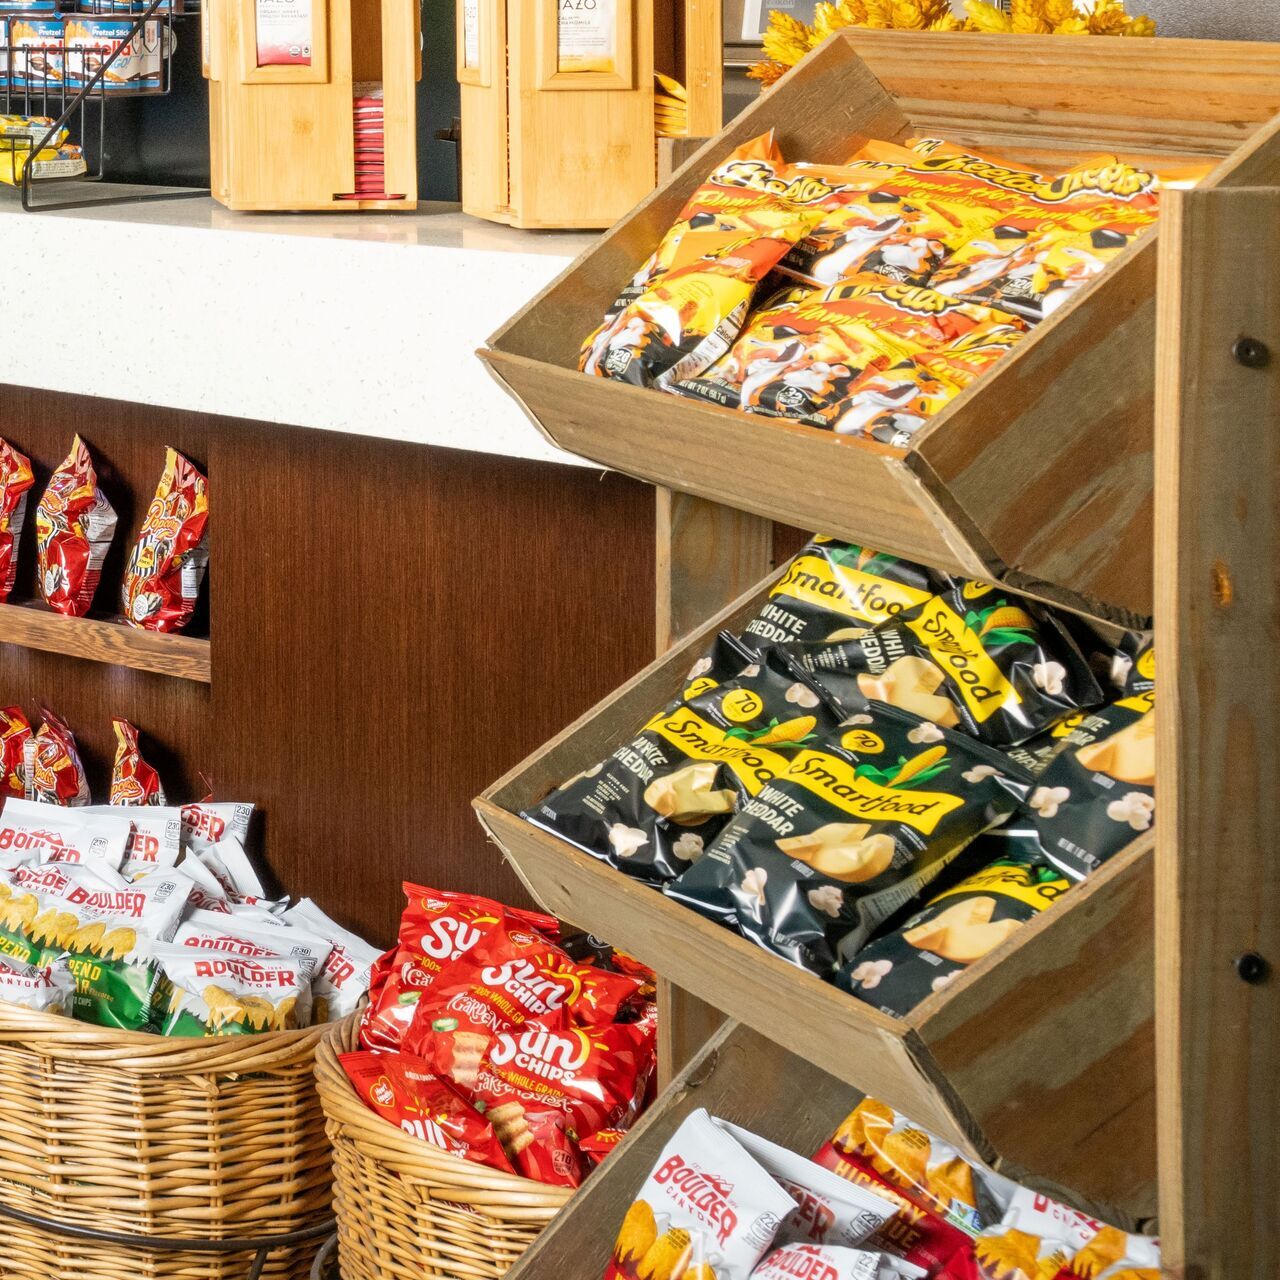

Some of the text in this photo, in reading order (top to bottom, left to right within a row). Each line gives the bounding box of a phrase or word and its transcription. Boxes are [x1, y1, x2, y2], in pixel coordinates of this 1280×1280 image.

[39, 29, 61, 37] Pretzel
[92, 29, 130, 37] Pretzel Stick
[23, 39, 63, 55] nutel
[74, 39, 131, 56] nutella
[921, 154, 1042, 194] Cheetos
[716, 324, 734, 343] Calori
[613, 349, 630, 363] 320
[780, 562, 905, 616] Smartfoo
[759, 604, 807, 635] WHITE
[746, 618, 800, 644] CHEDDA
[735, 693, 757, 714] 70
[853, 732, 878, 748] 70
[790, 757, 940, 817] Smartfood
[236, 805, 250, 816] 230
[759, 784, 805, 817] WHITE
[742, 800, 794, 836] HEDDAR
[159, 883, 175, 891] 230
[67, 886, 146, 918] BOULDER
[194, 961, 295, 987] BOULDER
[490, 992, 514, 1018] WHOLE
[515, 1052, 575, 1084] CHIPS
[508, 1072, 536, 1092] WHOLE
[554, 1150, 571, 1162] 210
[652, 1154, 738, 1248] BOULDER
[665, 1185, 715, 1228] CANYON
[760, 1212, 780, 1232] 220
[861, 1210, 885, 1227] 220
